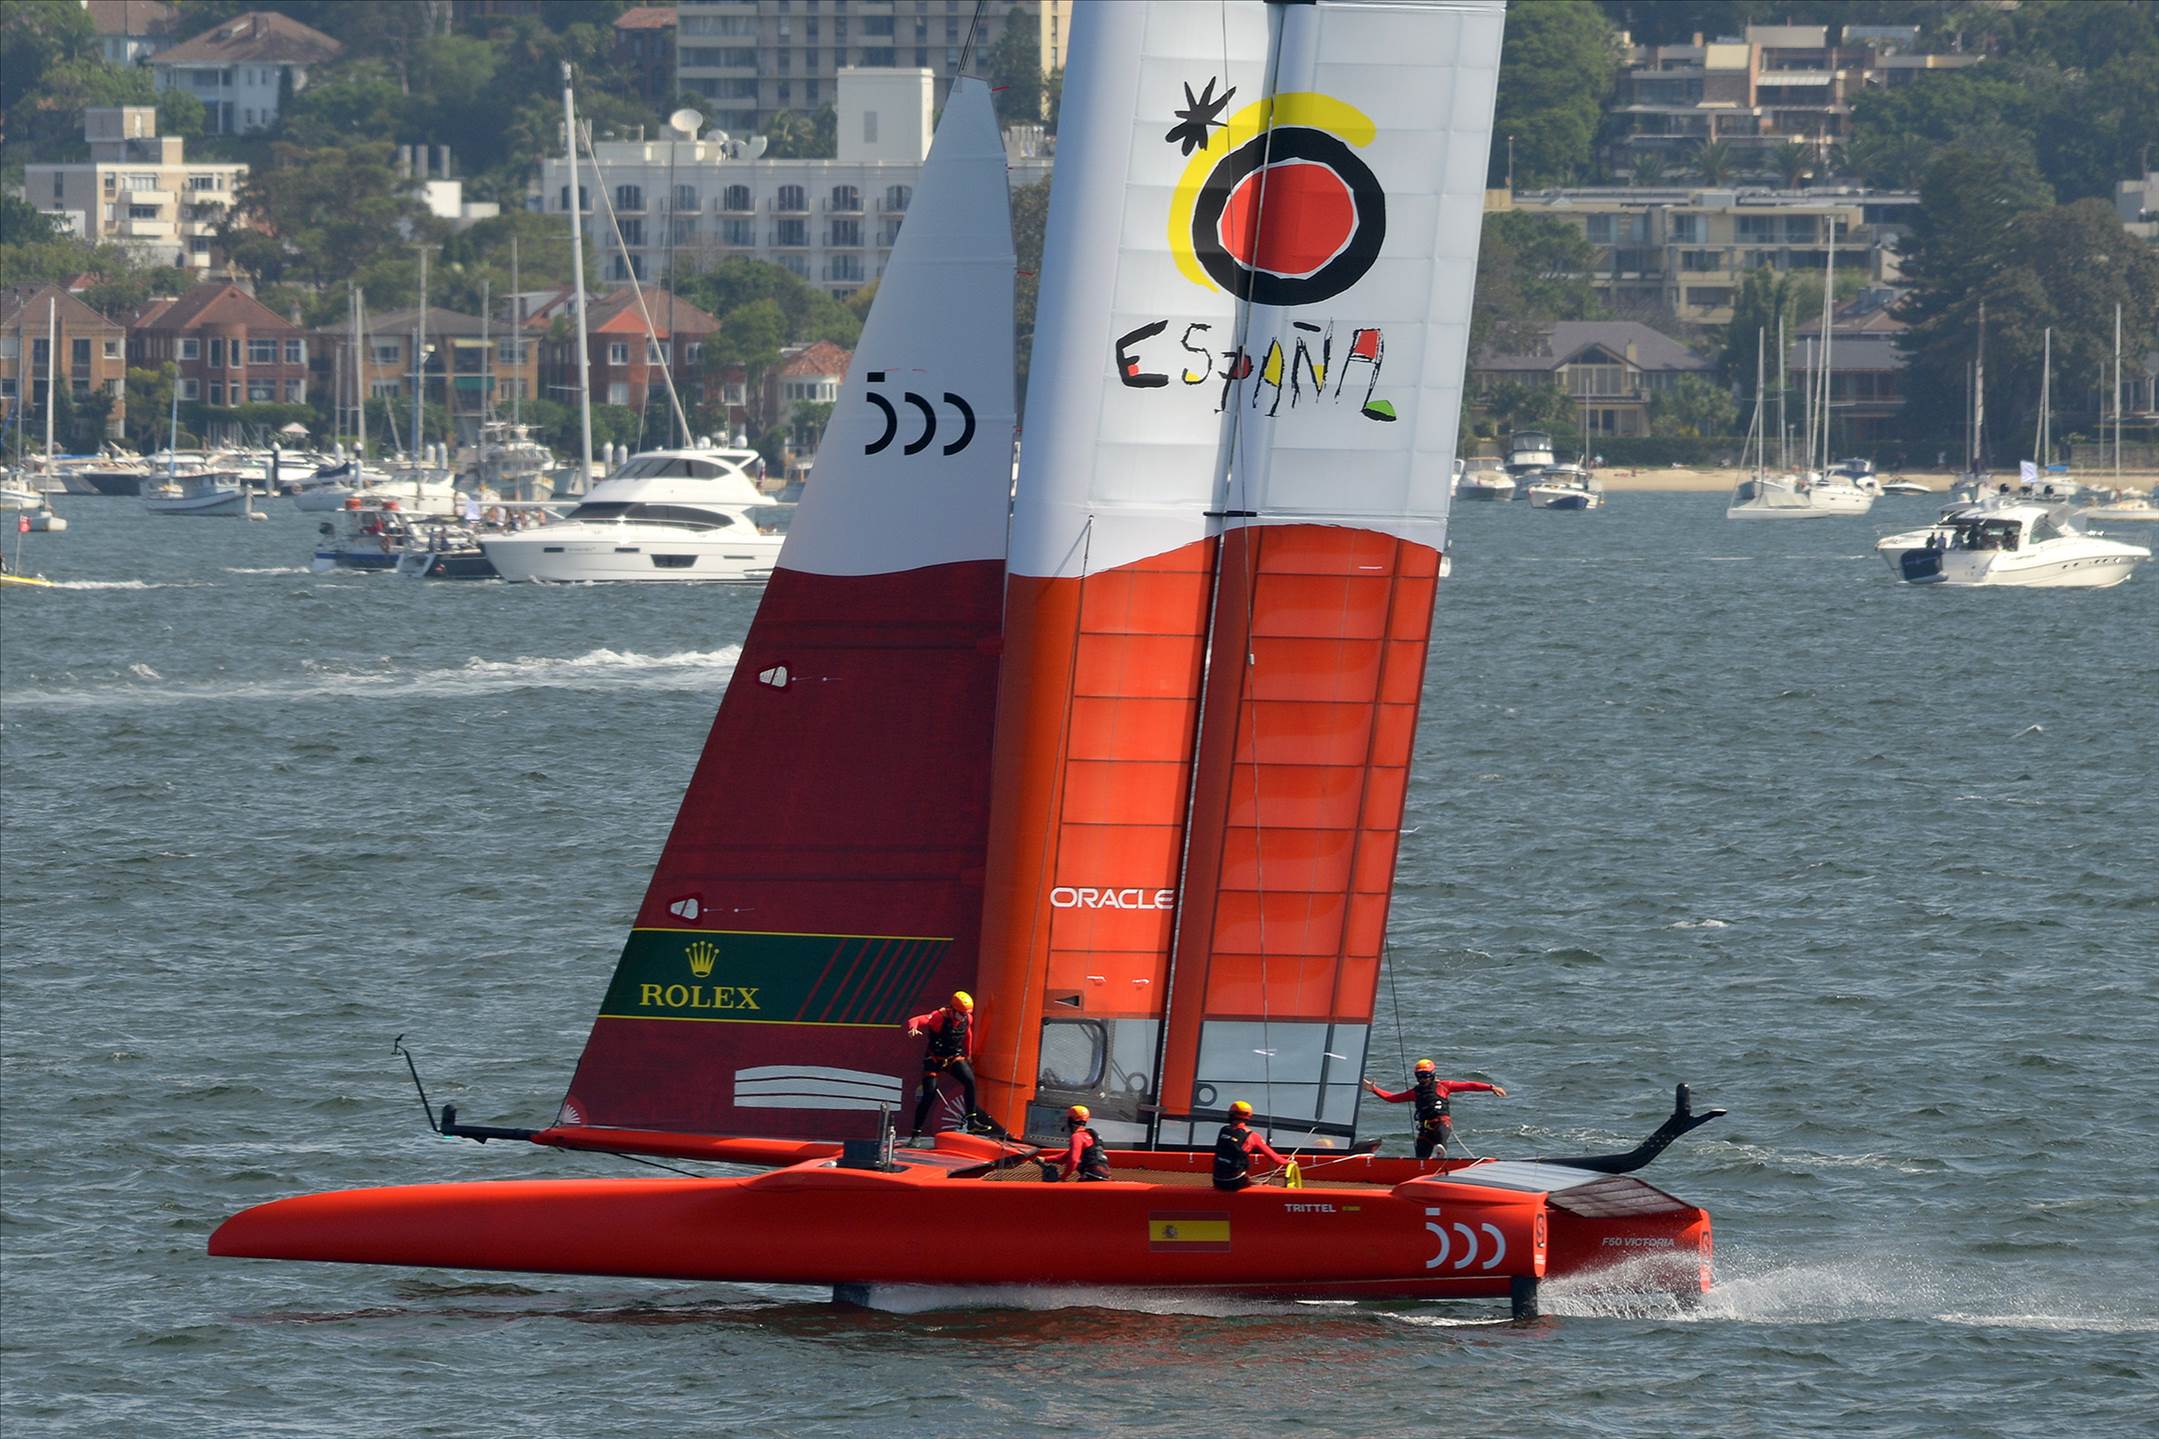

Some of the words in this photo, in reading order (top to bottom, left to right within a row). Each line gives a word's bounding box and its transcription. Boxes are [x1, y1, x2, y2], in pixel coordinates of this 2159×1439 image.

[1050, 887, 1174, 909] ORACLE
[639, 983, 760, 1009] ROLEX
[1284, 1203, 1337, 1213] TRITTEL
[1624, 1238, 1675, 1247] VICTORIA
